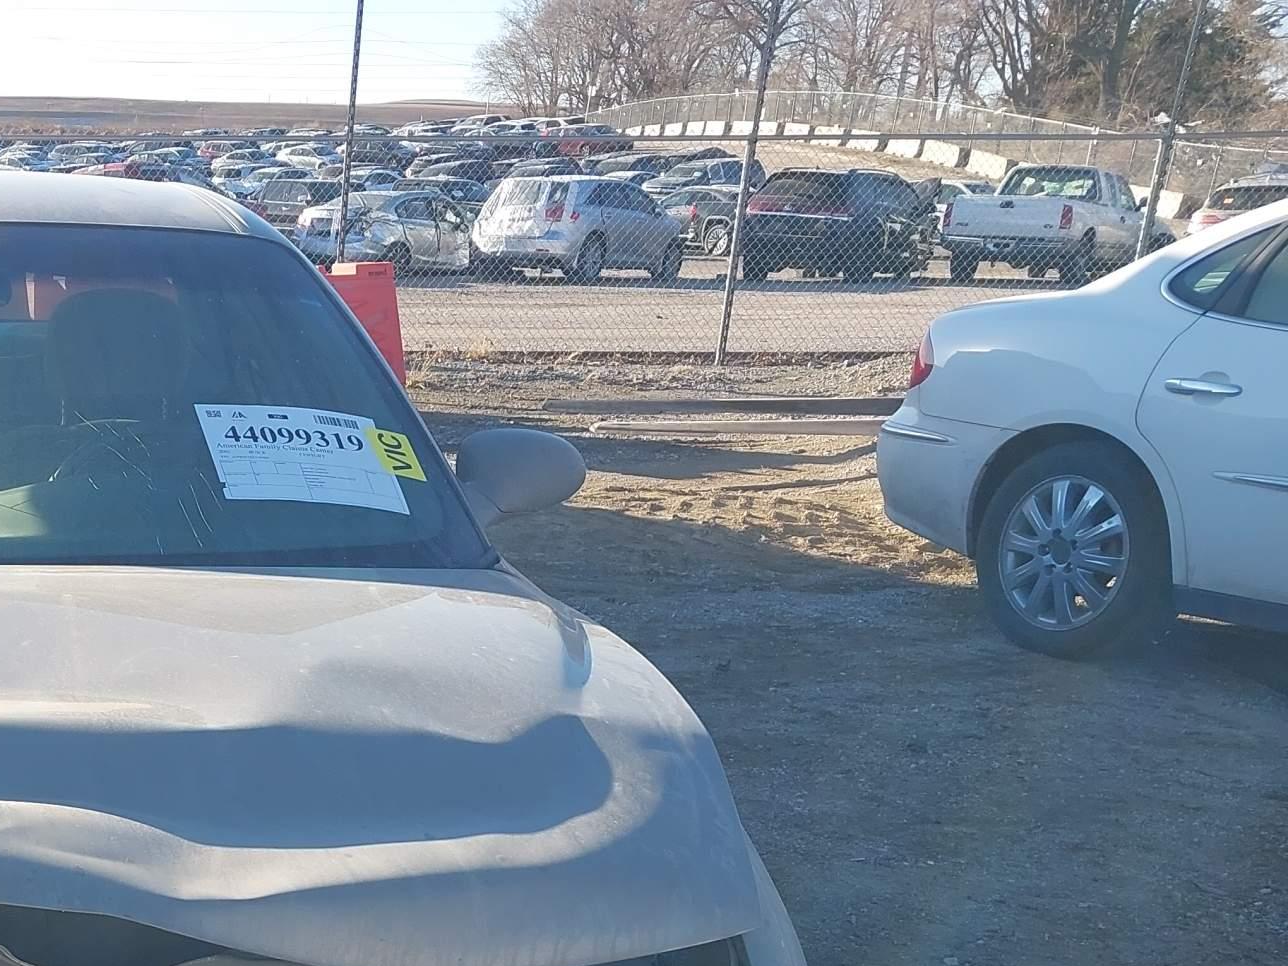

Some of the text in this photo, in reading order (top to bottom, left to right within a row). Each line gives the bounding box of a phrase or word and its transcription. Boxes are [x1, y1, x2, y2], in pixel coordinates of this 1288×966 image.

[224, 425, 364, 452] 44099319
[254, 443, 280, 451] Family
[282, 444, 308, 452] Claims
[377, 432, 413, 471] VIC
